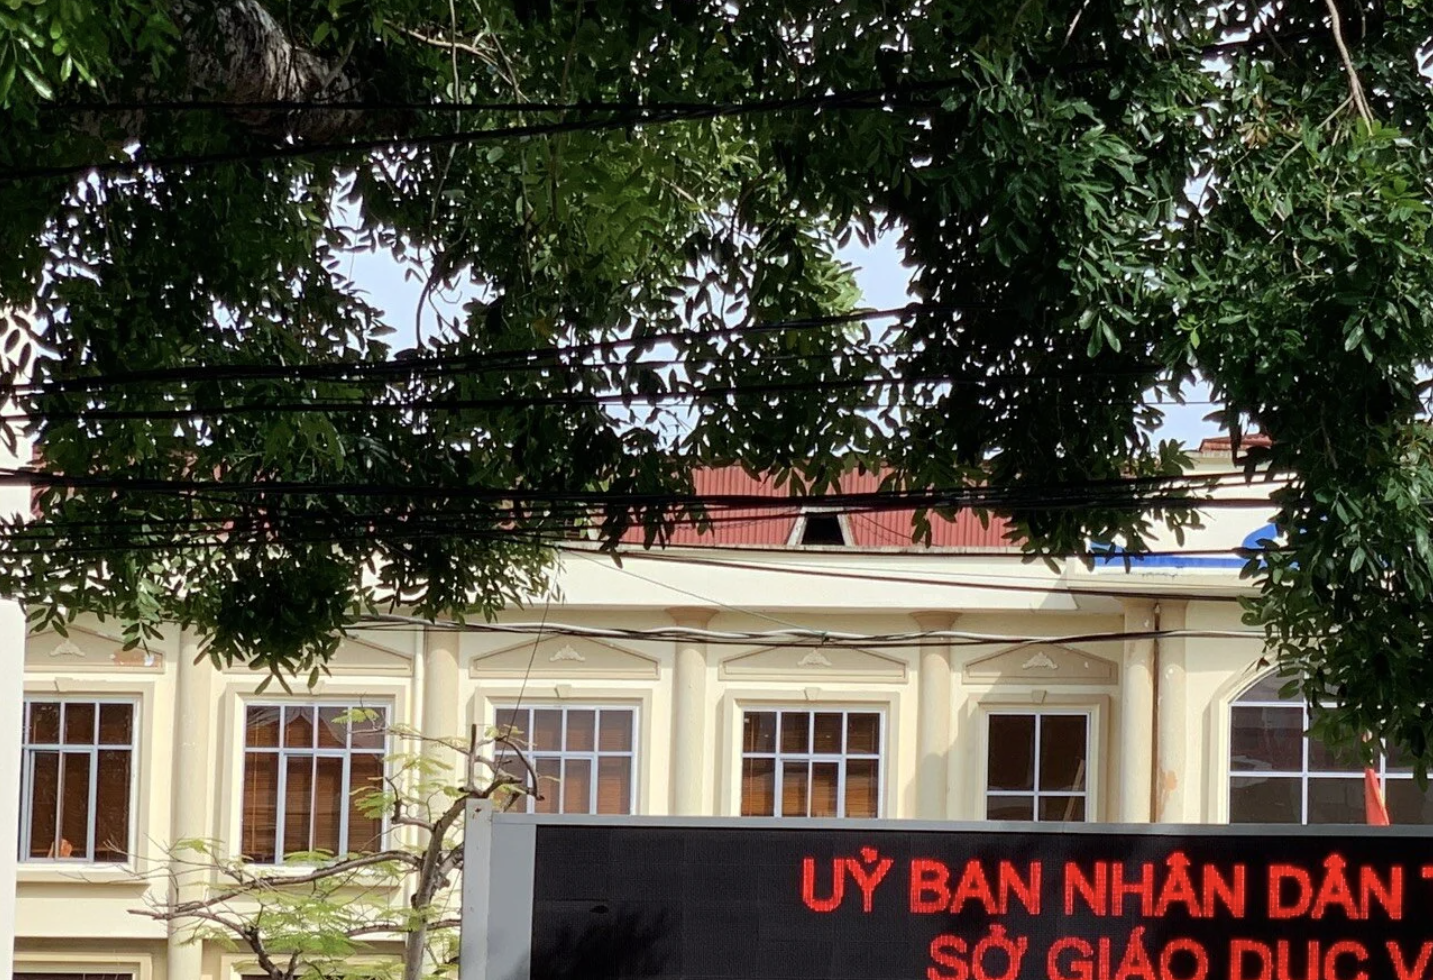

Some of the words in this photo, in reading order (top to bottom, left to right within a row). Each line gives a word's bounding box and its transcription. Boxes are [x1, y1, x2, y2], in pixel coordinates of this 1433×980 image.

[910, 860, 1041, 915] BAN
[1065, 852, 1245, 918] NHÂN
[1268, 854, 1403, 920] DÂN
